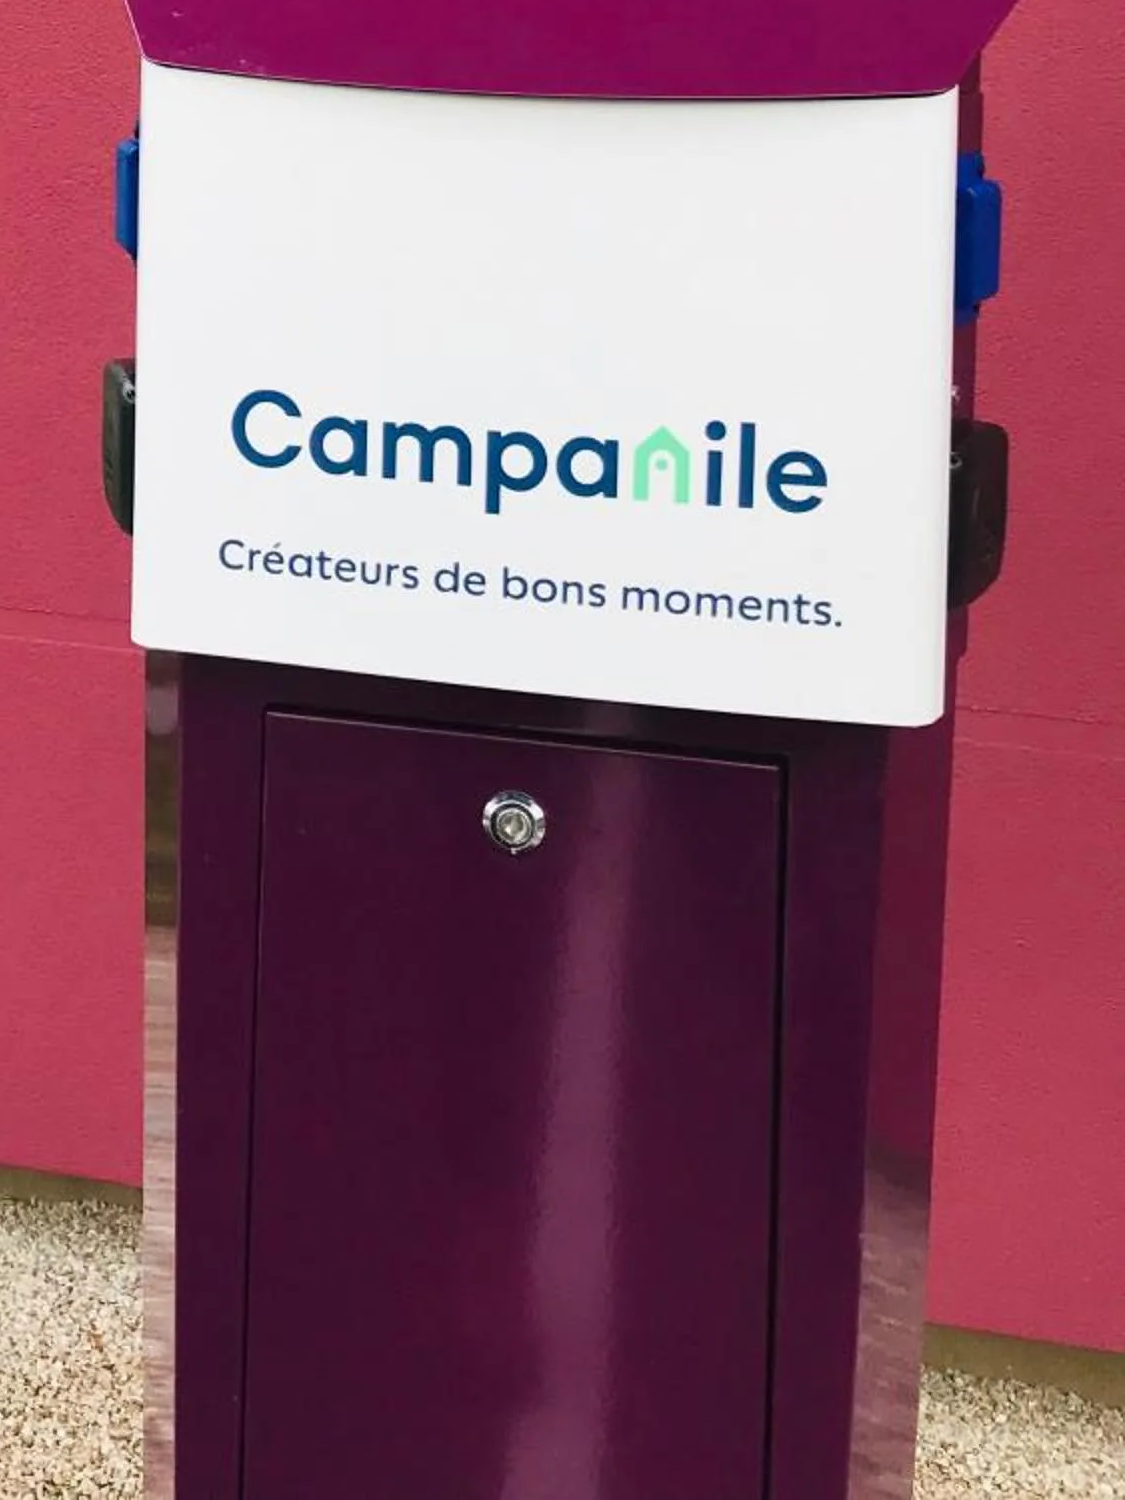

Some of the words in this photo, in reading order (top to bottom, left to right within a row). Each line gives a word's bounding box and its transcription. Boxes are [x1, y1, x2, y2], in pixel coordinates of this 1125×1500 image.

[230, 388, 828, 516] Campanile
[218, 539, 420, 590] Créateurs
[433, 561, 487, 598] de
[502, 566, 607, 609] bons
[622, 586, 843, 629] moments.
